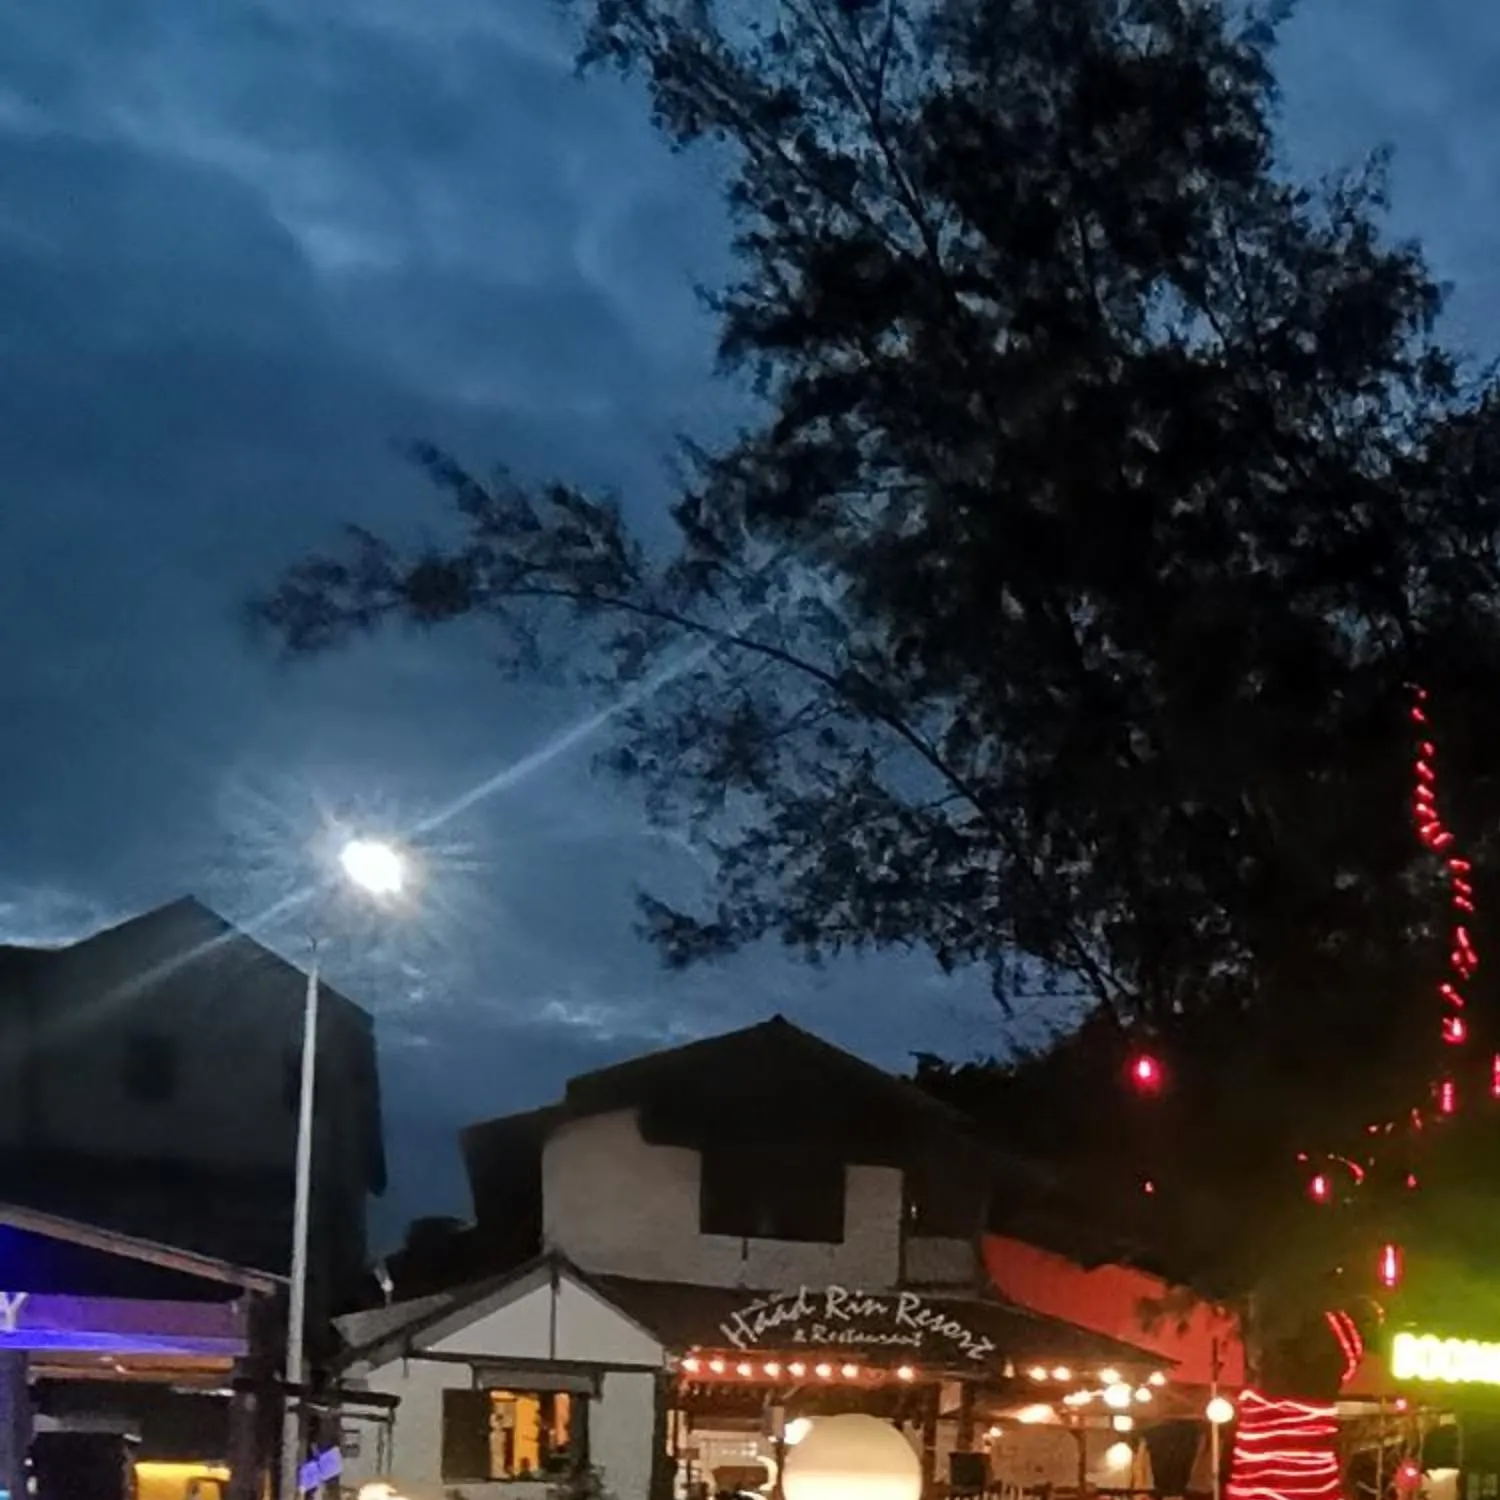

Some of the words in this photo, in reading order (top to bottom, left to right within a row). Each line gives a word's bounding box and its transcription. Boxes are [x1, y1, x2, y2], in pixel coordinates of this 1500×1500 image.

[811, 1323, 923, 1346] Restaurant
[824, 1284, 888, 1320] Rin
[895, 1291, 997, 1360] Resort
